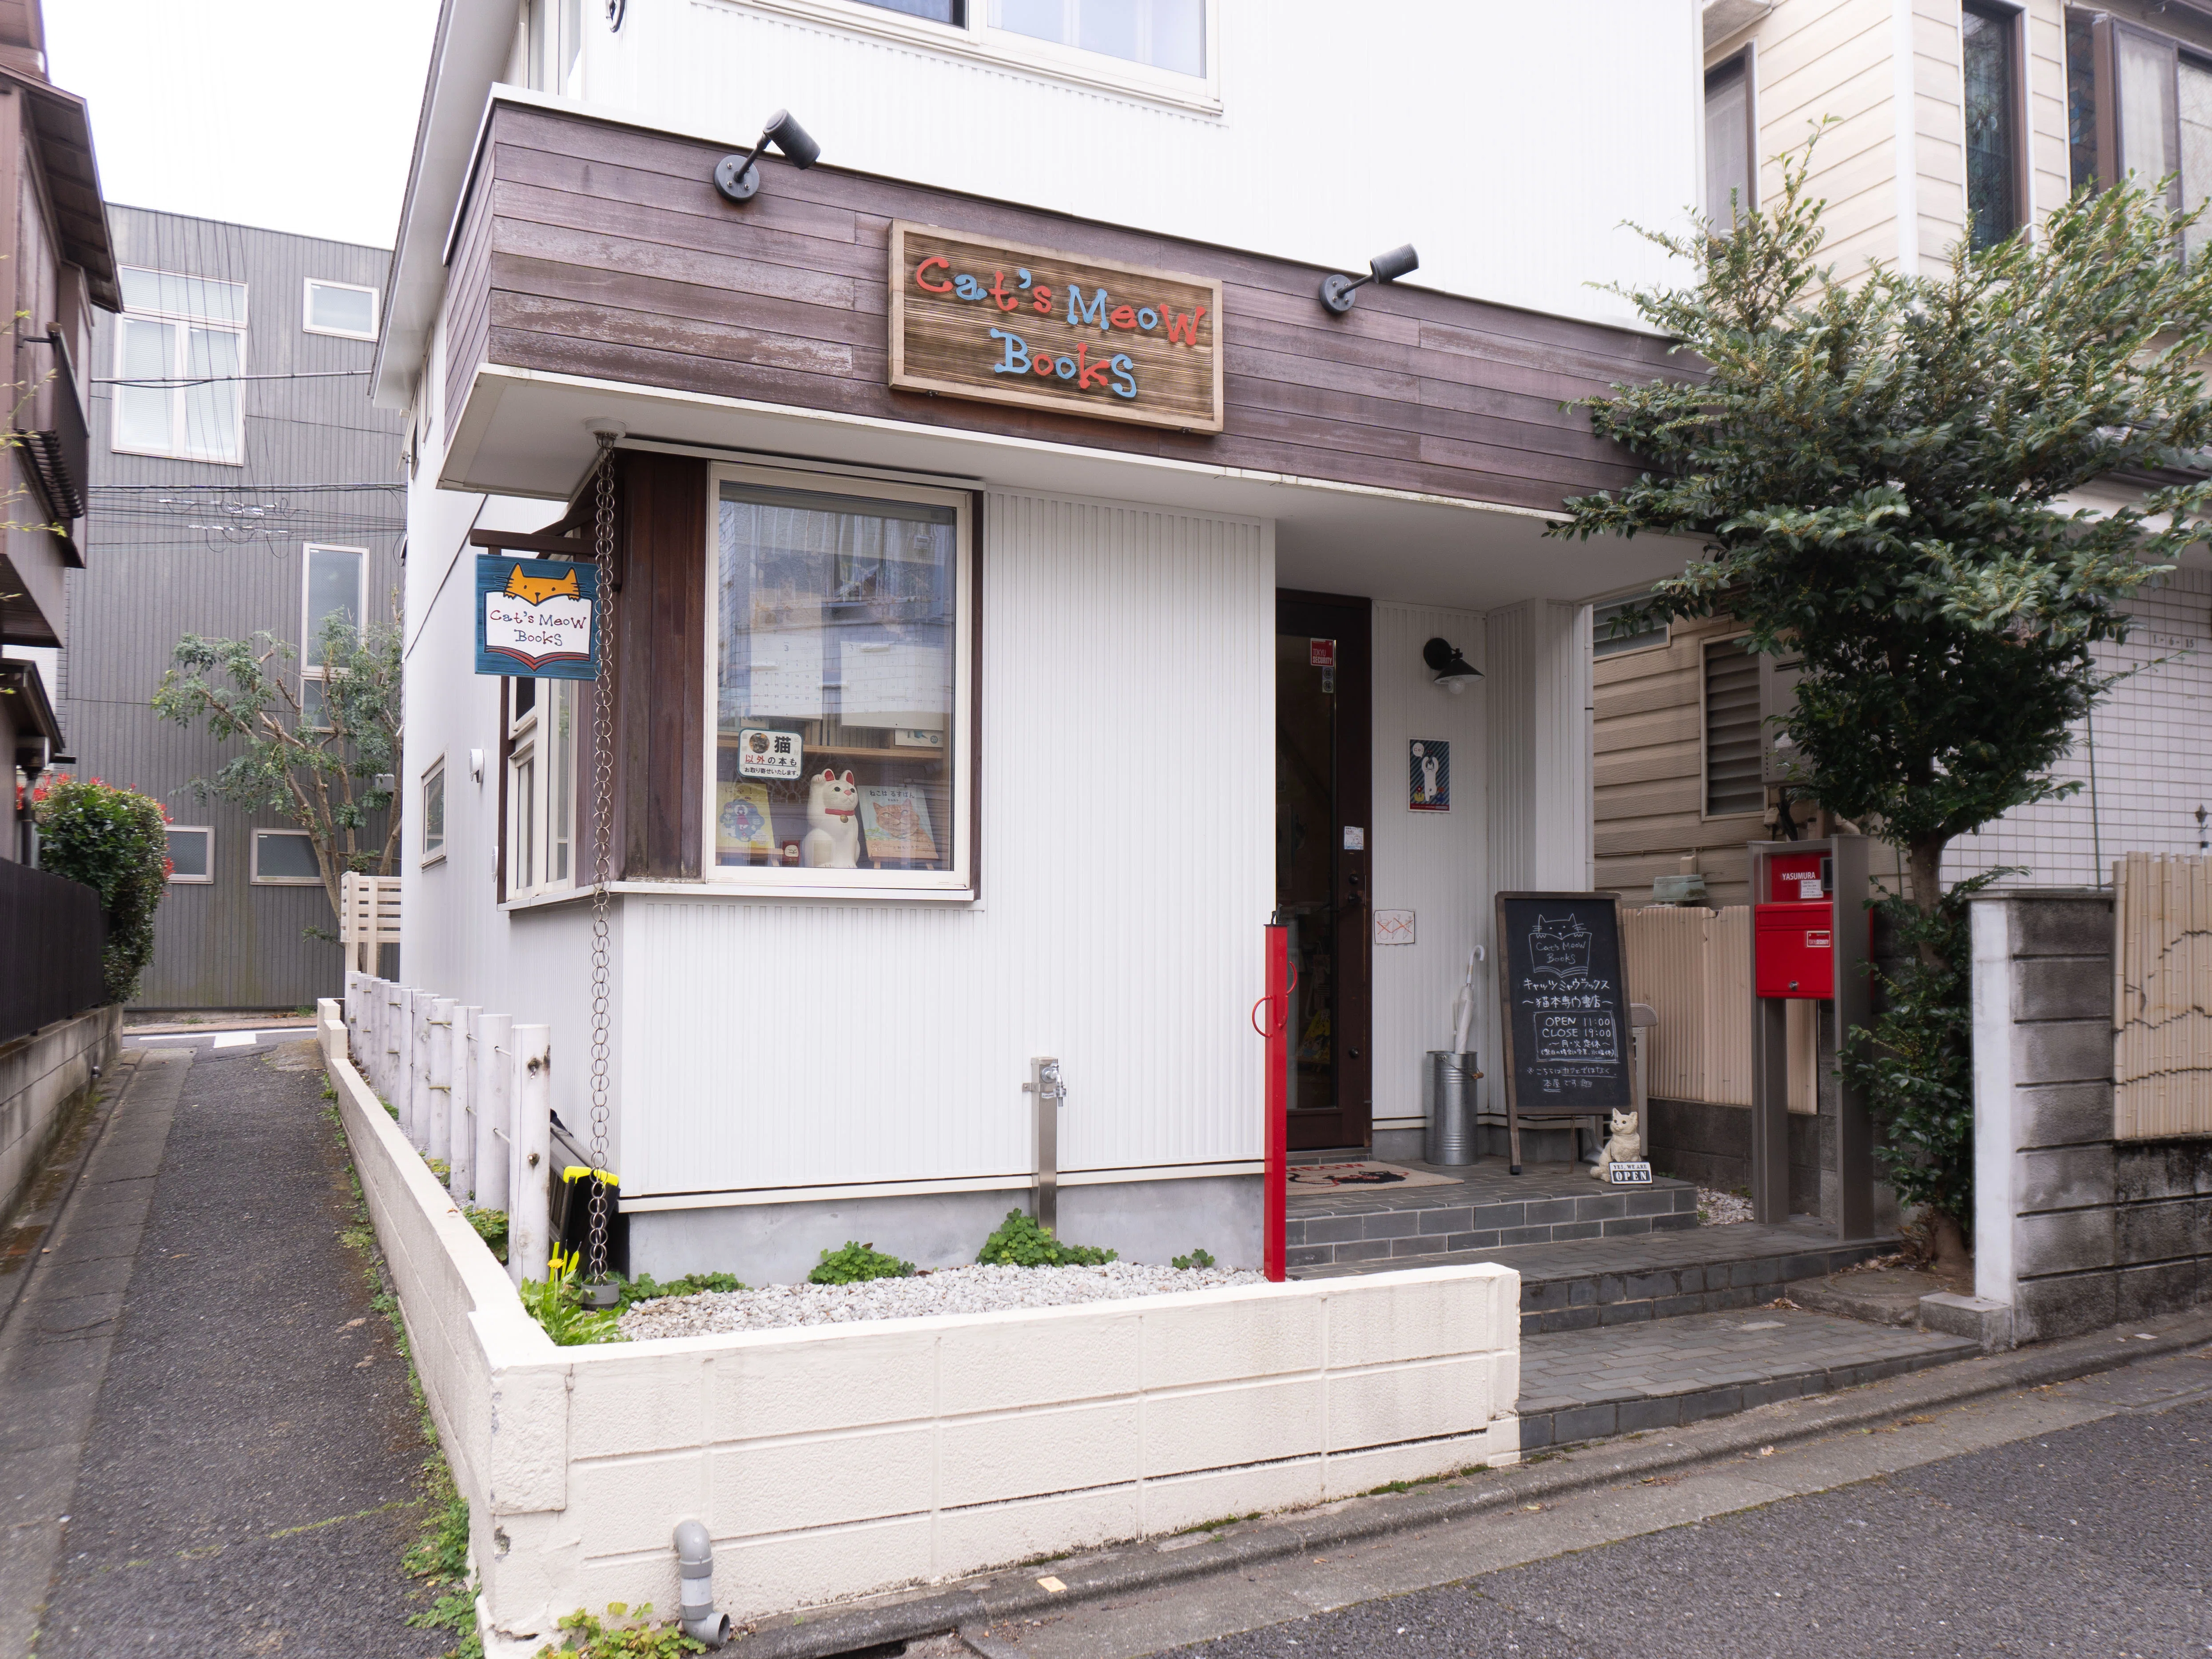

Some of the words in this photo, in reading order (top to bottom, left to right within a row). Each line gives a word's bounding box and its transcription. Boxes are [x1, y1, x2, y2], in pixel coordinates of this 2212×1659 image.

[915, 256, 1052, 314] Cat's
[490, 610, 534, 624] Cat's
[1313, 648, 1326, 657] TOKYU
[1313, 656, 1332, 665] SECURITY
[774, 736, 792, 754] 猫
[745, 754, 797, 766] 以外の本も
[744, 767, 799, 776] お取り寄せいたします。
[1782, 871, 1816, 881] YASUMURA
[1536, 942, 1560, 951] Cat's
[1546, 1017, 1576, 1027] OPEN
[1583, 1017, 1610, 1026] 11:00
[1542, 1028, 1578, 1038] CLOSE
[1585, 1028, 1611, 1038] 19:00
[1615, 1171, 1647, 1181] OPEN
